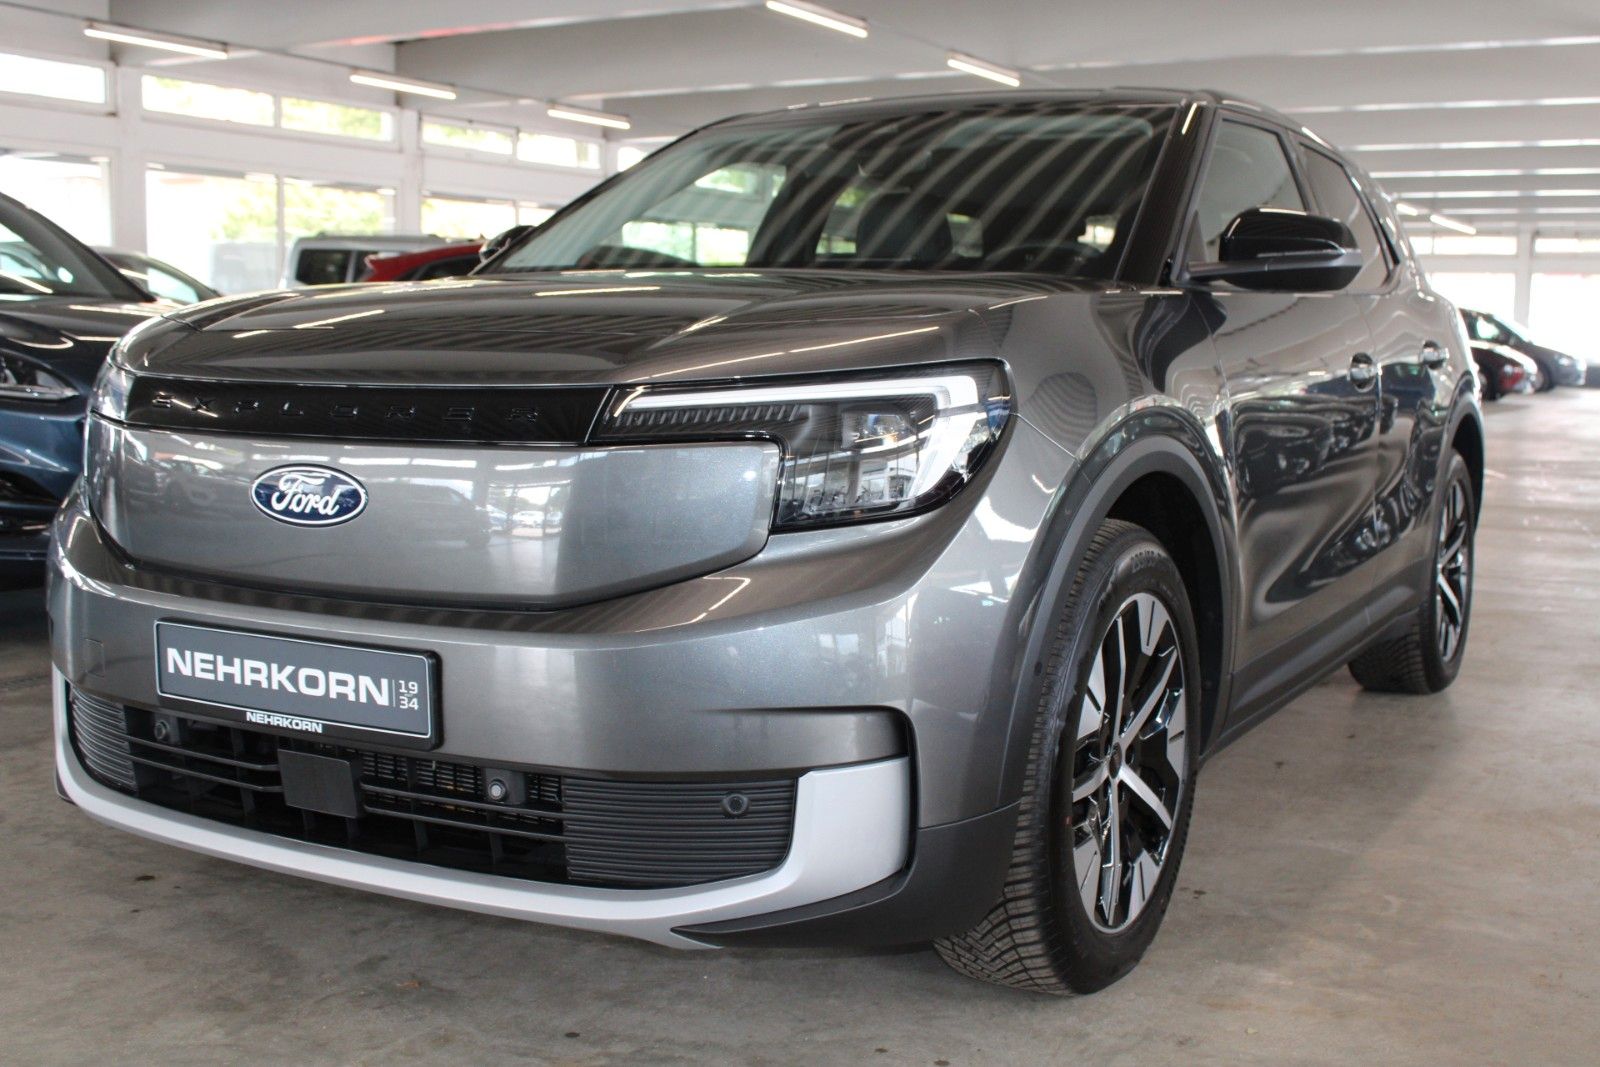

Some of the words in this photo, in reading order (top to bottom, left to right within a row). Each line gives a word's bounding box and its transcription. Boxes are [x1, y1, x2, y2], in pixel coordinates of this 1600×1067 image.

[271, 473, 340, 516] Ford
[166, 647, 390, 706] NEHRKORN
[398, 679, 419, 694] 19
[398, 695, 419, 711] 34
[246, 711, 323, 734] NEHRKORN
